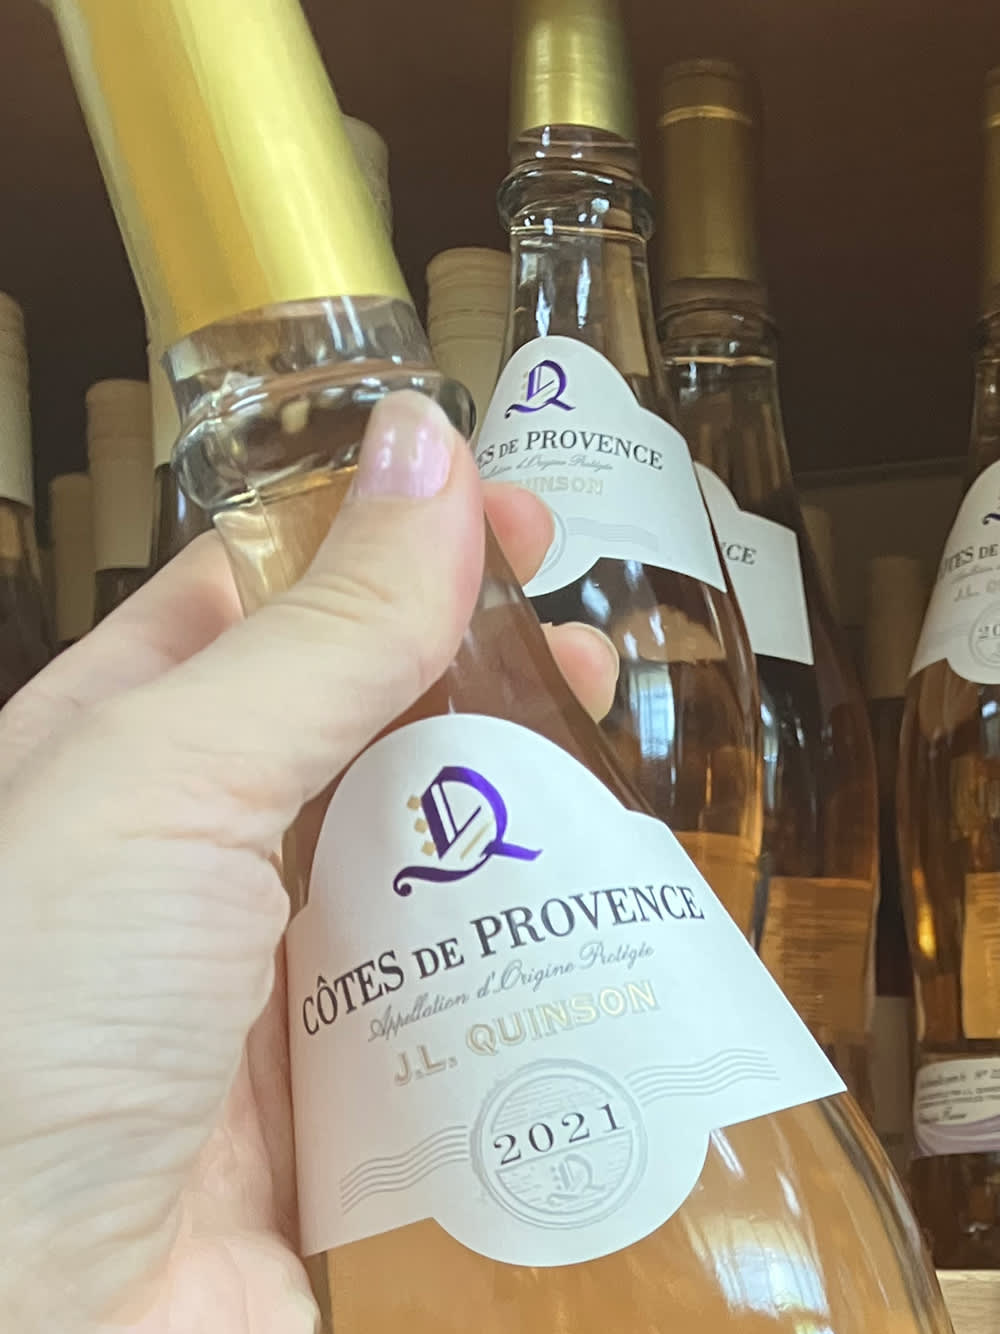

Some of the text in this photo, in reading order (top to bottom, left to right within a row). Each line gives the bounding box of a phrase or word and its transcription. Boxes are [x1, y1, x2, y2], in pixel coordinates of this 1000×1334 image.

[498, 438, 519, 459] DE
[525, 429, 664, 471] PROVENCE
[978, 543, 999, 560] DE
[302, 883, 706, 1036] CÔTES DE PROVENCE
[367, 992, 471, 1042] Appellation
[393, 978, 661, 1088] J.L. QUINSON
[492, 1102, 626, 1166] 2021
